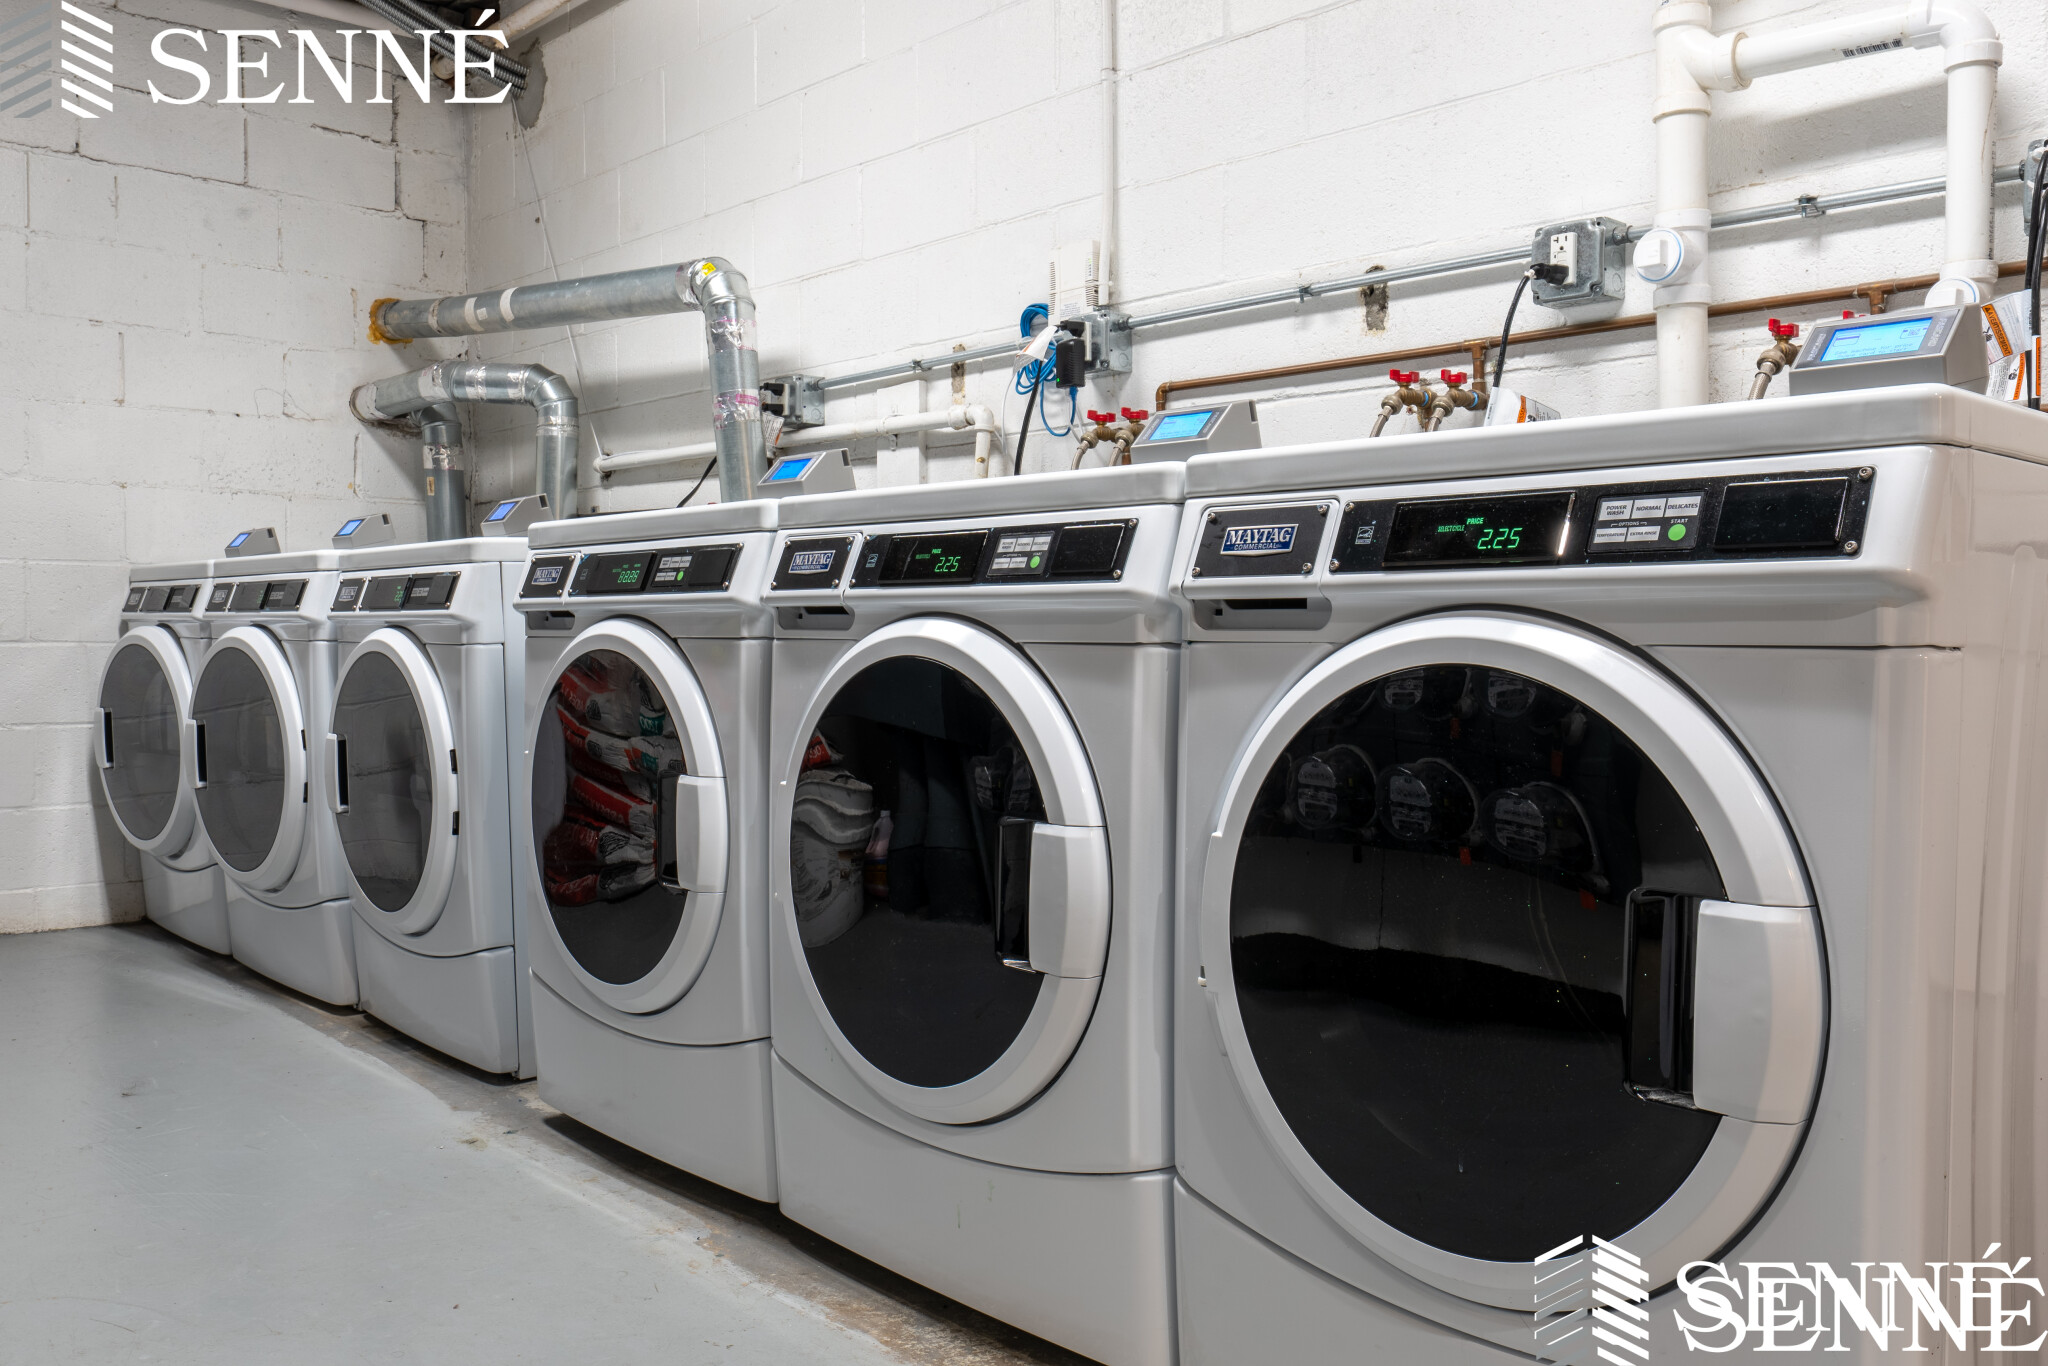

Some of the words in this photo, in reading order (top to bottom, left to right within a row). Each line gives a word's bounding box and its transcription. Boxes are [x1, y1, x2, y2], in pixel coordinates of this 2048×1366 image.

[1226, 528, 1292, 545] MAYTAG
[1477, 528, 1523, 549] 2.25
[1234, 543, 1277, 551] COMMERCIAL
[793, 554, 832, 566] MAYTAG
[934, 556, 962, 572] 2.25
